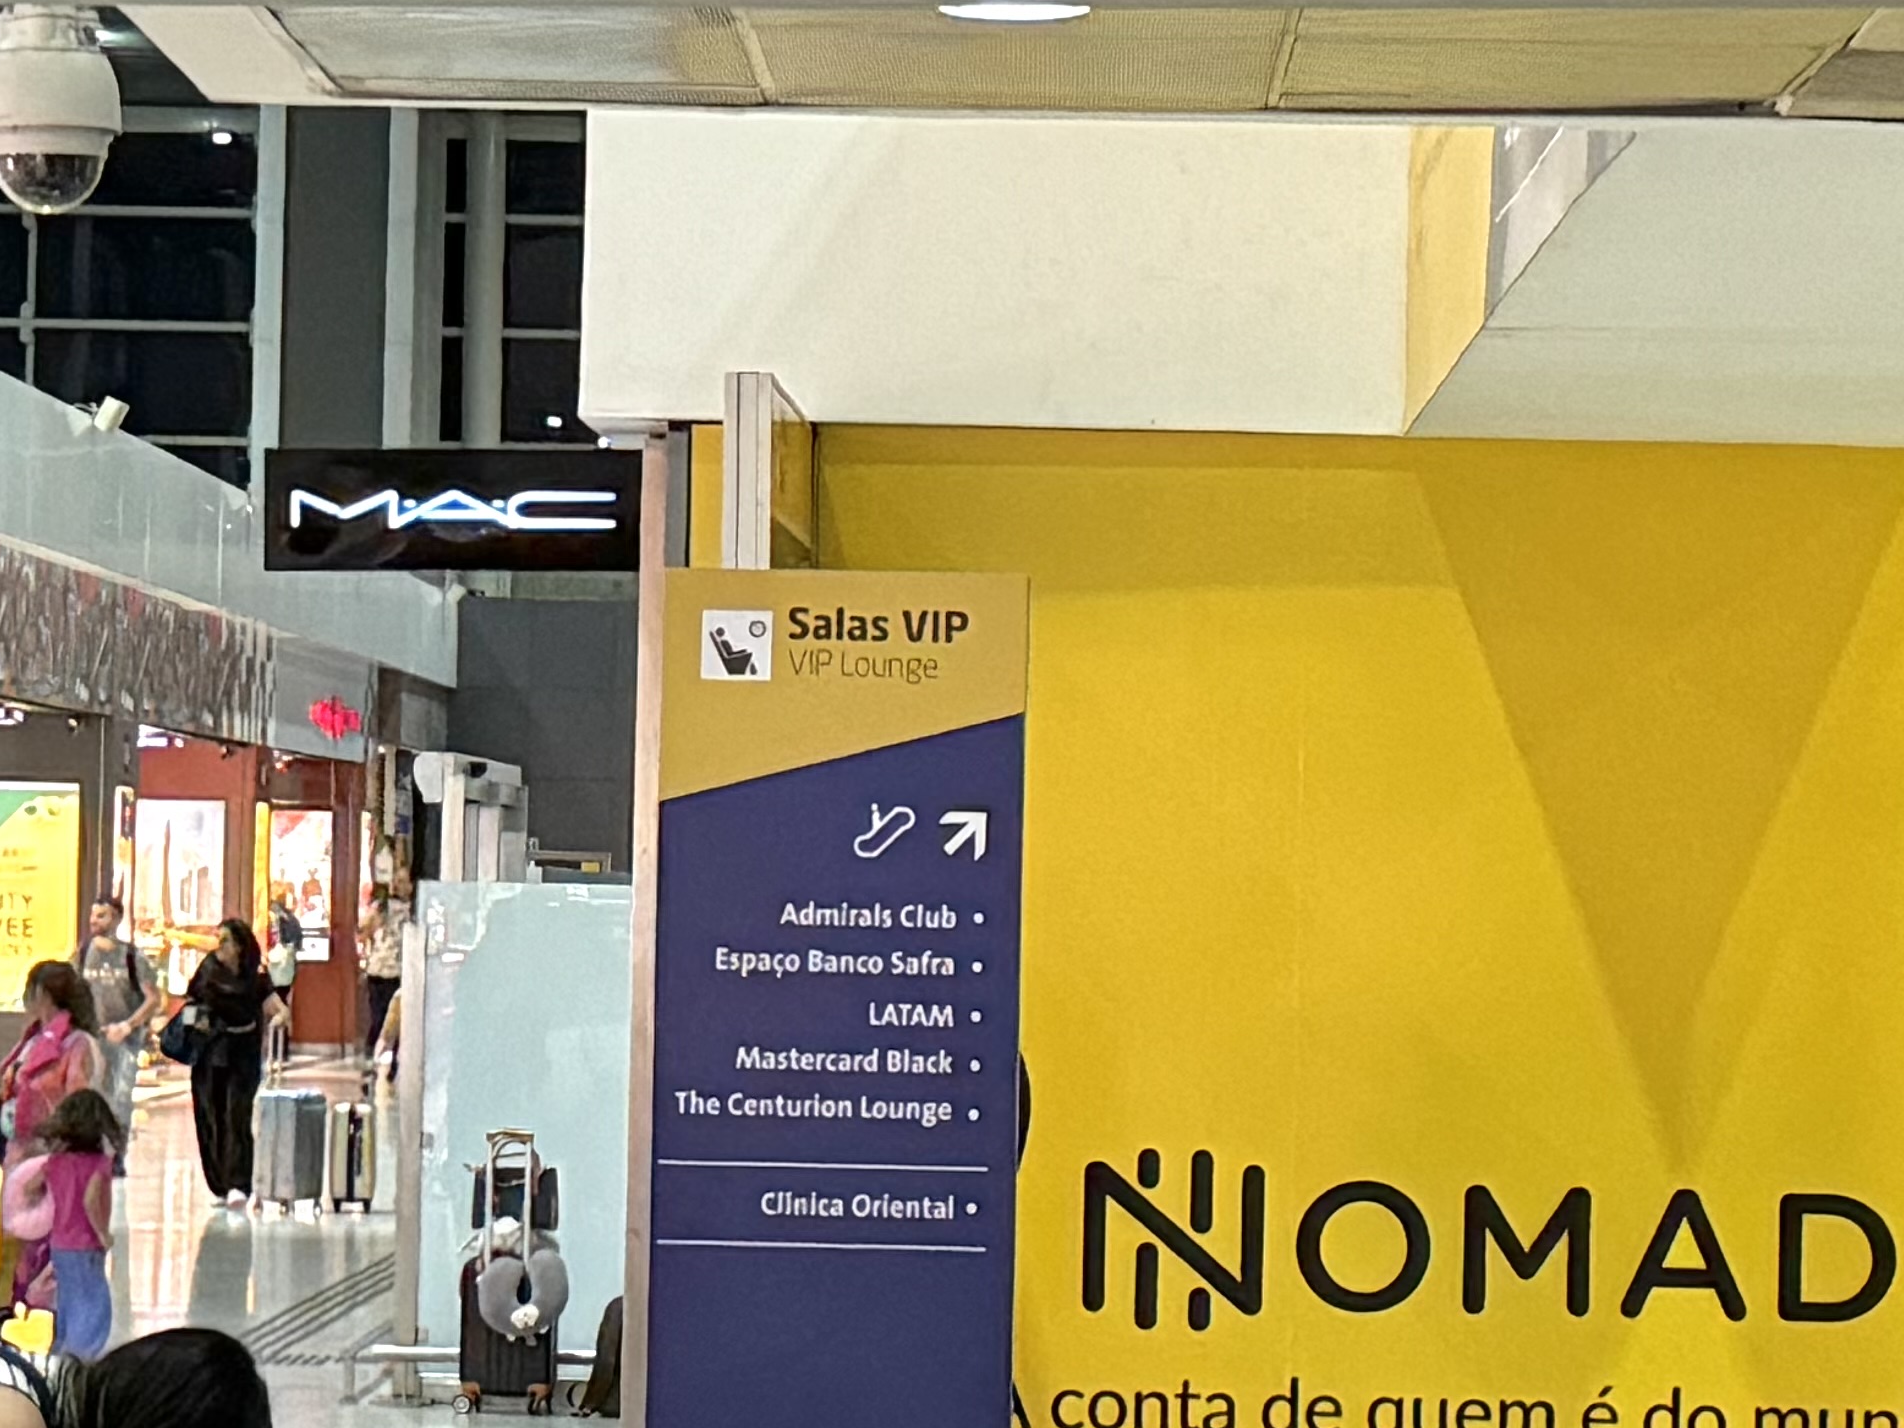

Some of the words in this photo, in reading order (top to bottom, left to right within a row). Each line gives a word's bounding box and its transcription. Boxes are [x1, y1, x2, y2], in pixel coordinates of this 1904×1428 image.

[789, 607, 888, 641] Salas
[903, 611, 968, 643] VIP
[790, 650, 832, 674] VIP
[842, 653, 937, 683] Lounge
[780, 901, 892, 927] Admirals
[900, 904, 956, 928] Club
[716, 947, 800, 978] Espaço
[808, 950, 883, 974] Banco
[891, 950, 954, 975] Safra
[870, 1003, 953, 1027] LATAM
[736, 1047, 878, 1072] Mastercard
[887, 1049, 952, 1073] Black
[675, 1090, 720, 1114] The
[728, 1093, 852, 1117] Centurion
[861, 1096, 951, 1127] Lounge
[761, 1192, 843, 1216] Clínica
[852, 1194, 953, 1219] Oriental
[1082, 1148, 1898, 1332] NOMAD
